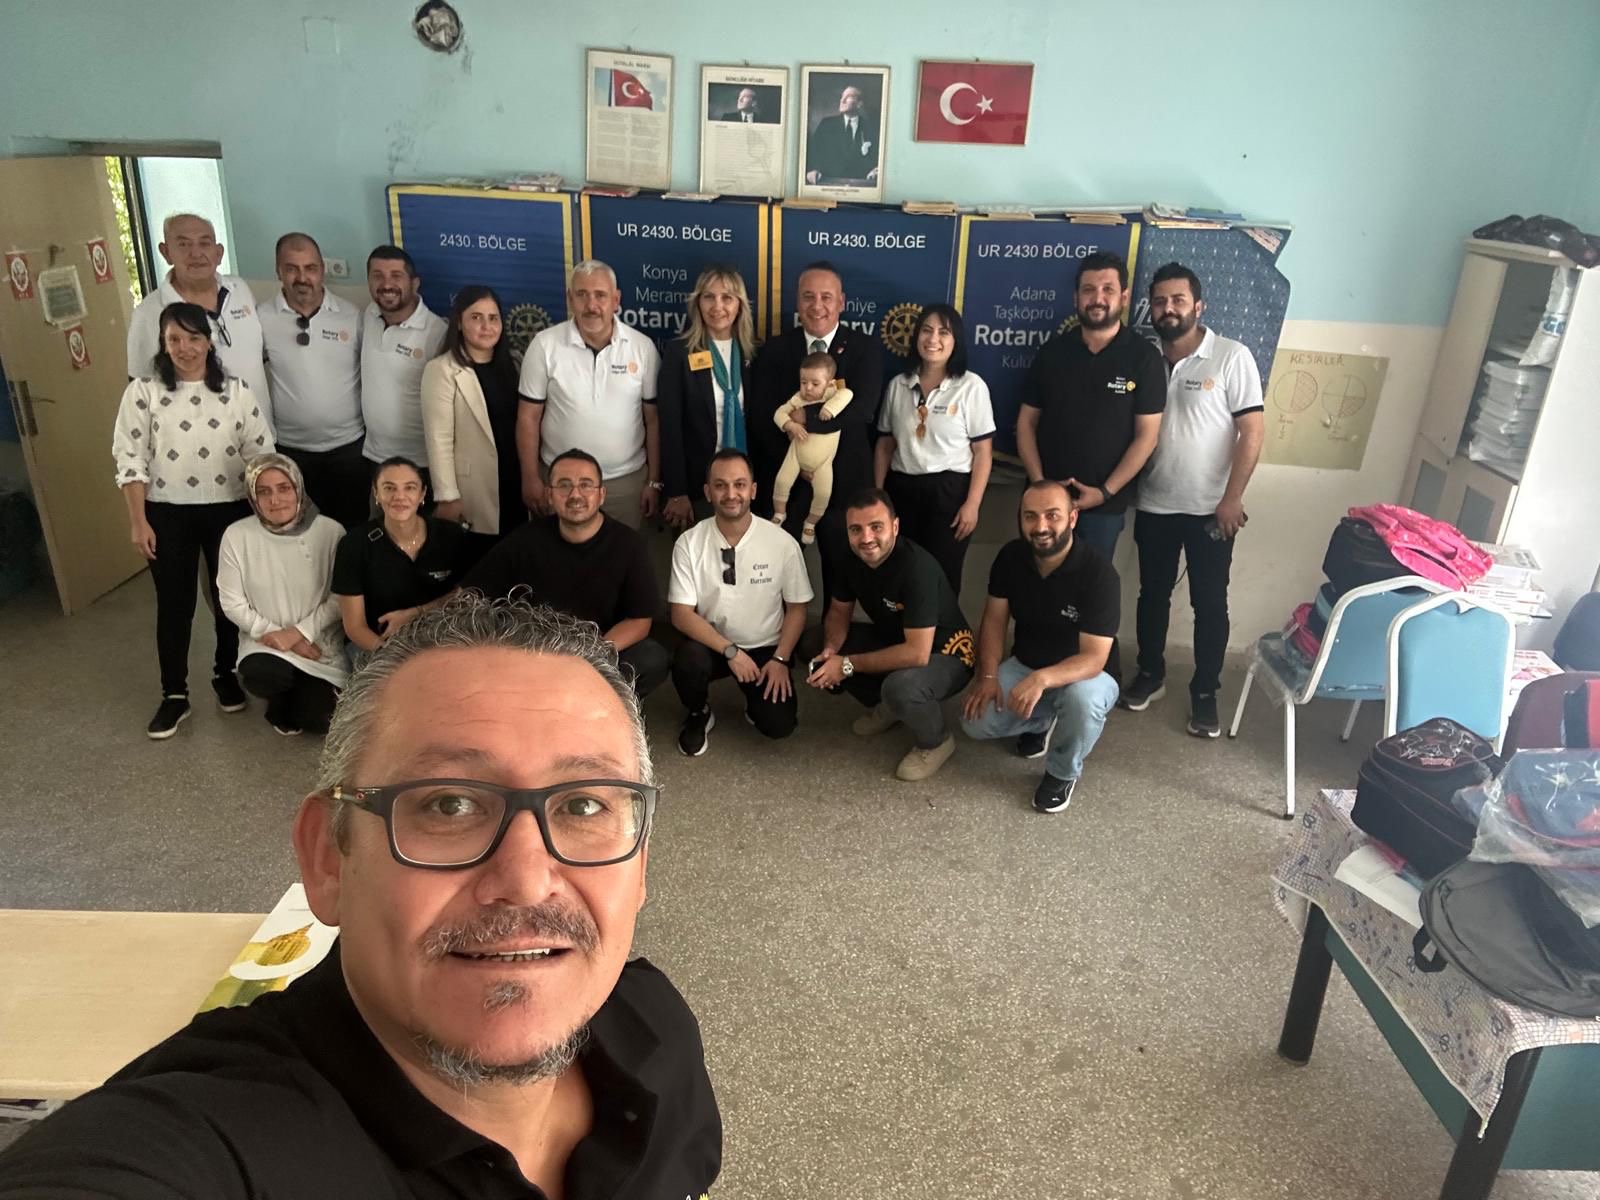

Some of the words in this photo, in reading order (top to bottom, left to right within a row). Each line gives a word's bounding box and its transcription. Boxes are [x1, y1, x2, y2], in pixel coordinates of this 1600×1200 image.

[617, 223, 638, 238] UR
[642, 225, 678, 240] 2430.
[682, 223, 733, 243] BÖLGE
[808, 231, 830, 246] UR
[833, 233, 871, 248] 2430.
[874, 231, 927, 249] BÖLGE
[440, 234, 475, 249] 2430.
[478, 234, 527, 252] BÖLGE
[978, 244, 1001, 258] UR
[1004, 244, 1039, 258] 2430
[642, 264, 688, 284] Konya
[1010, 286, 1056, 301] Adana
[993, 304, 1055, 323] Taşköprü
